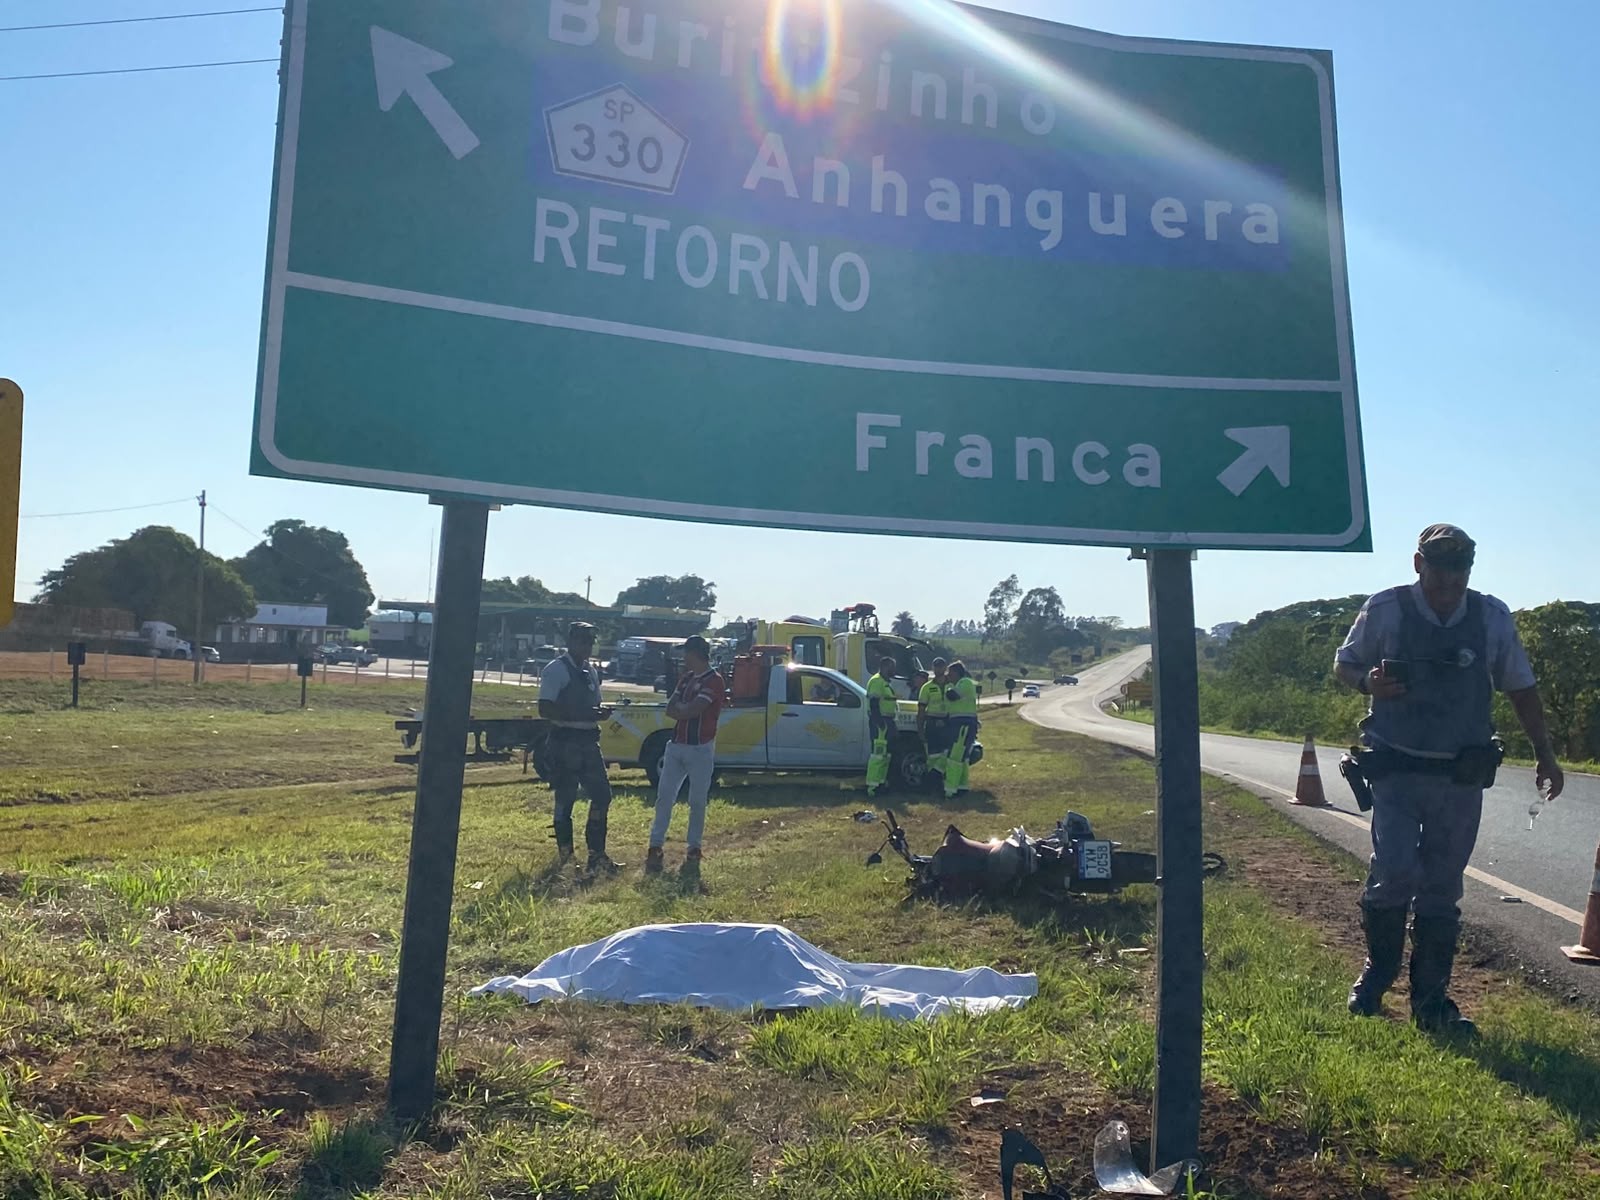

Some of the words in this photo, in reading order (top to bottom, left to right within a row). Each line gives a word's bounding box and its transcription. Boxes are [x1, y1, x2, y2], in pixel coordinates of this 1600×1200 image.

[547, 0, 1057, 136] Buriizinho
[604, 100, 635, 123] SP
[570, 124, 663, 174] 330
[743, 132, 1280, 251] Anhanguera
[533, 197, 871, 312] RETORNO
[855, 411, 1162, 490] Franca
